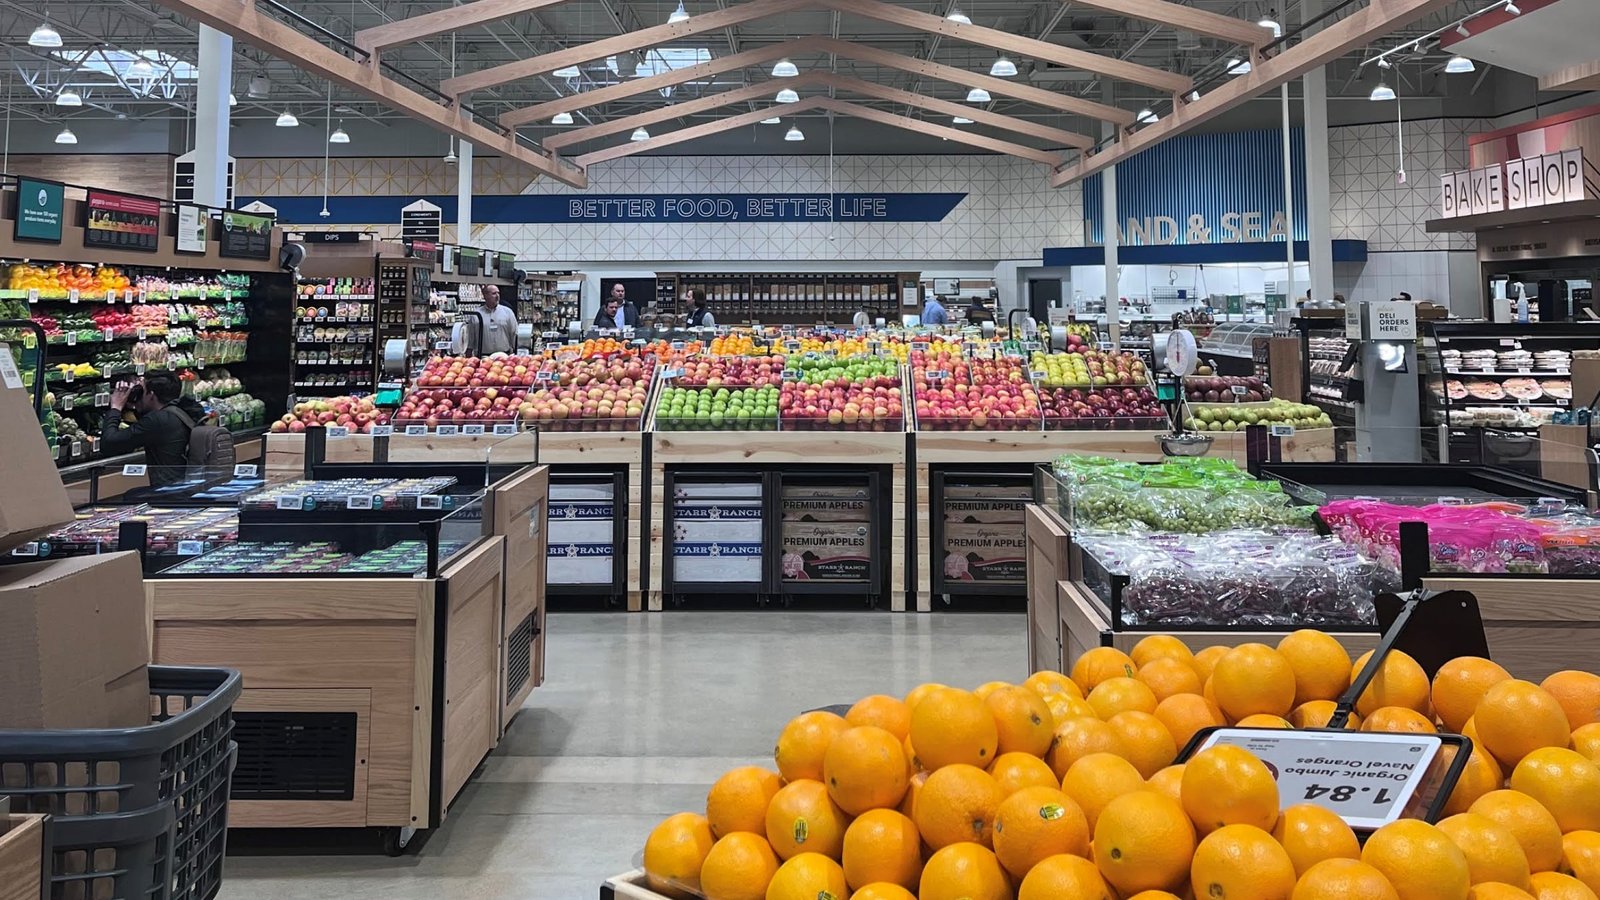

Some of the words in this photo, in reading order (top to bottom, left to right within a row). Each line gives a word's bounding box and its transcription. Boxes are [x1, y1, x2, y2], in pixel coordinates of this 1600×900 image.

[1444, 174, 1499, 211] BAKE
[1511, 160, 1578, 202] SHOP
[253, 203, 261, 212] 2
[569, 199, 656, 218] BETTER
[663, 198, 739, 220] FOOD,
[746, 198, 832, 217] BETTER
[840, 198, 887, 217] LIFE
[1186, 213, 1211, 245] &
[1221, 210, 1288, 244] SEA
[783, 501, 827, 510] PREMIUM
[829, 501, 864, 510] APPLES
[945, 502, 989, 511] PREMIUM
[783, 538, 828, 546] PREMIUM
[829, 538, 865, 546] APPLES
[947, 539, 992, 548] PREMIUM
[1296, 757, 1363, 768] Oranges
[1366, 761, 1415, 771] Navel
[1284, 767, 1340, 777] Jumbo
[1342, 770, 1408, 781] Organic
[1303, 784, 1392, 804] 1.84
